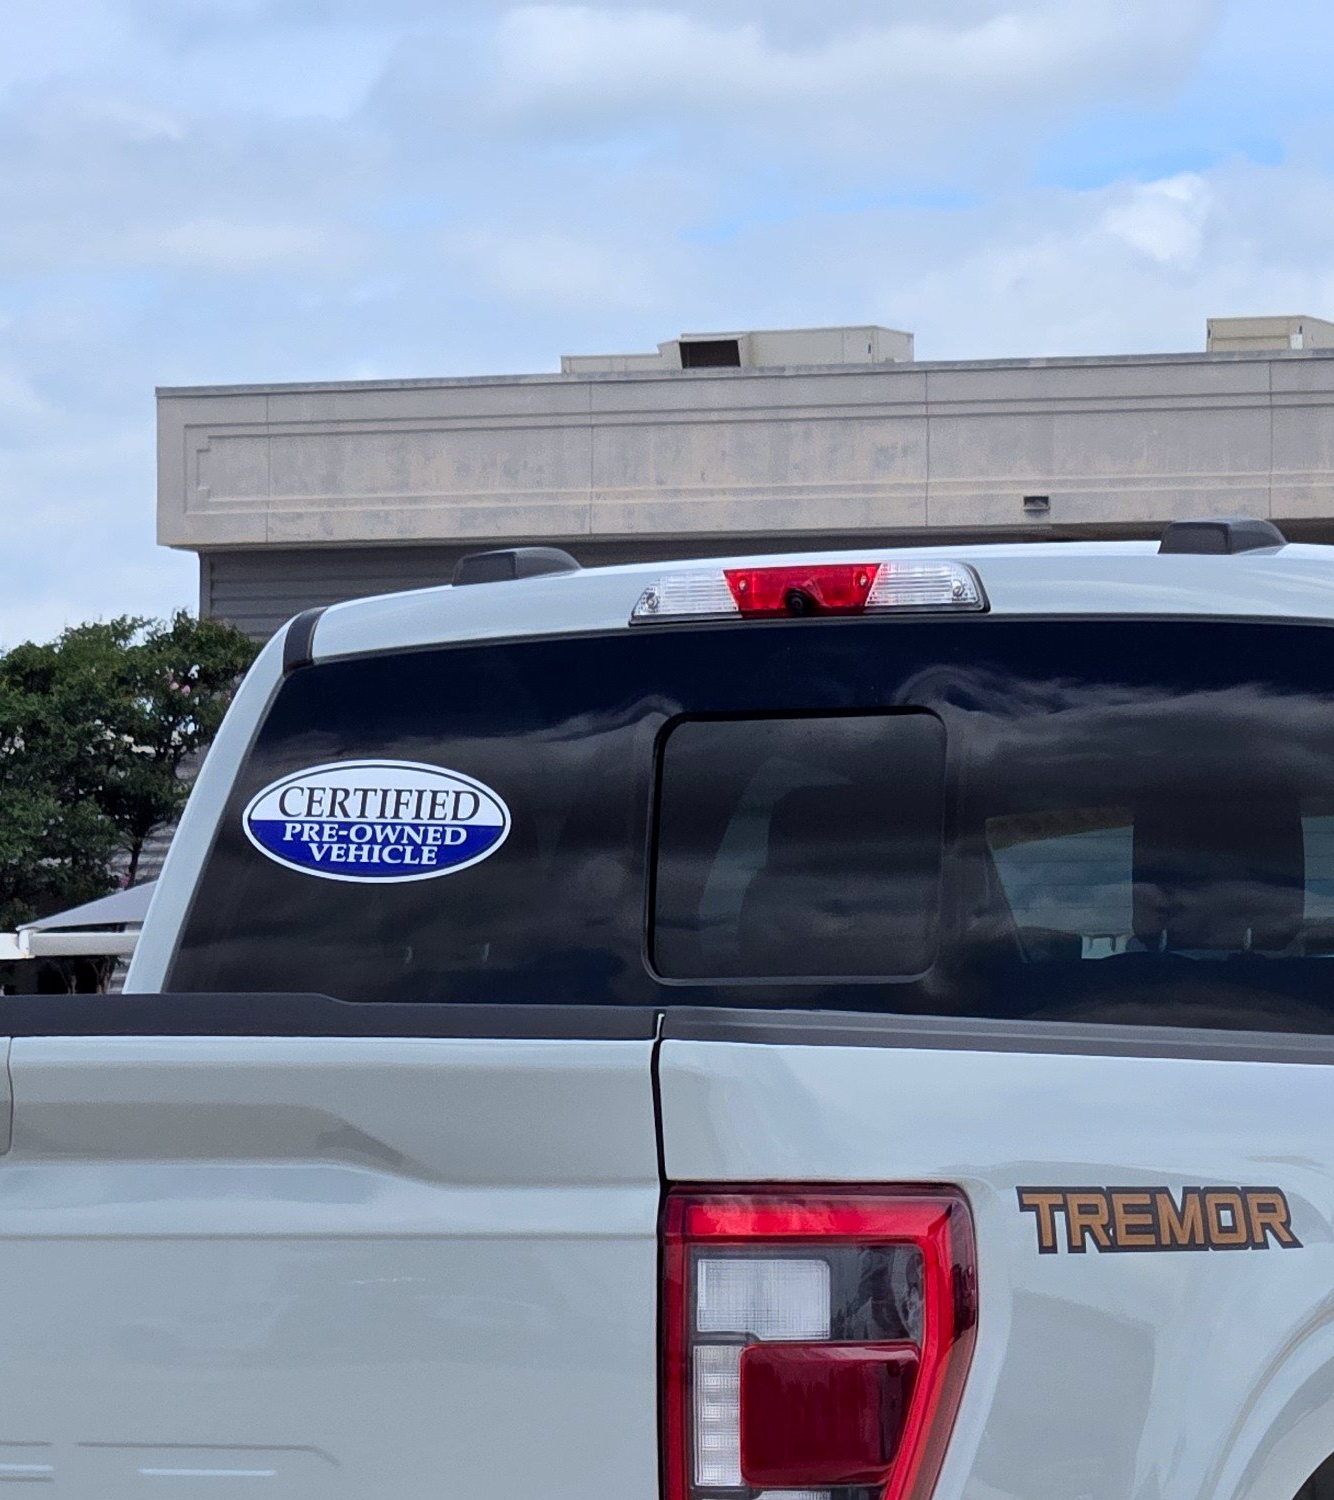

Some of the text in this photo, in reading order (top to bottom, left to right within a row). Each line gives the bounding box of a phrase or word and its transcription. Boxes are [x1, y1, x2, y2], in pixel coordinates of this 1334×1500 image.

[278, 786, 481, 822] CERTIFIED
[283, 822, 468, 846] PRE-OWNED
[308, 842, 438, 865] VEHICLE
[1015, 1186, 1304, 1254] TREMOR
